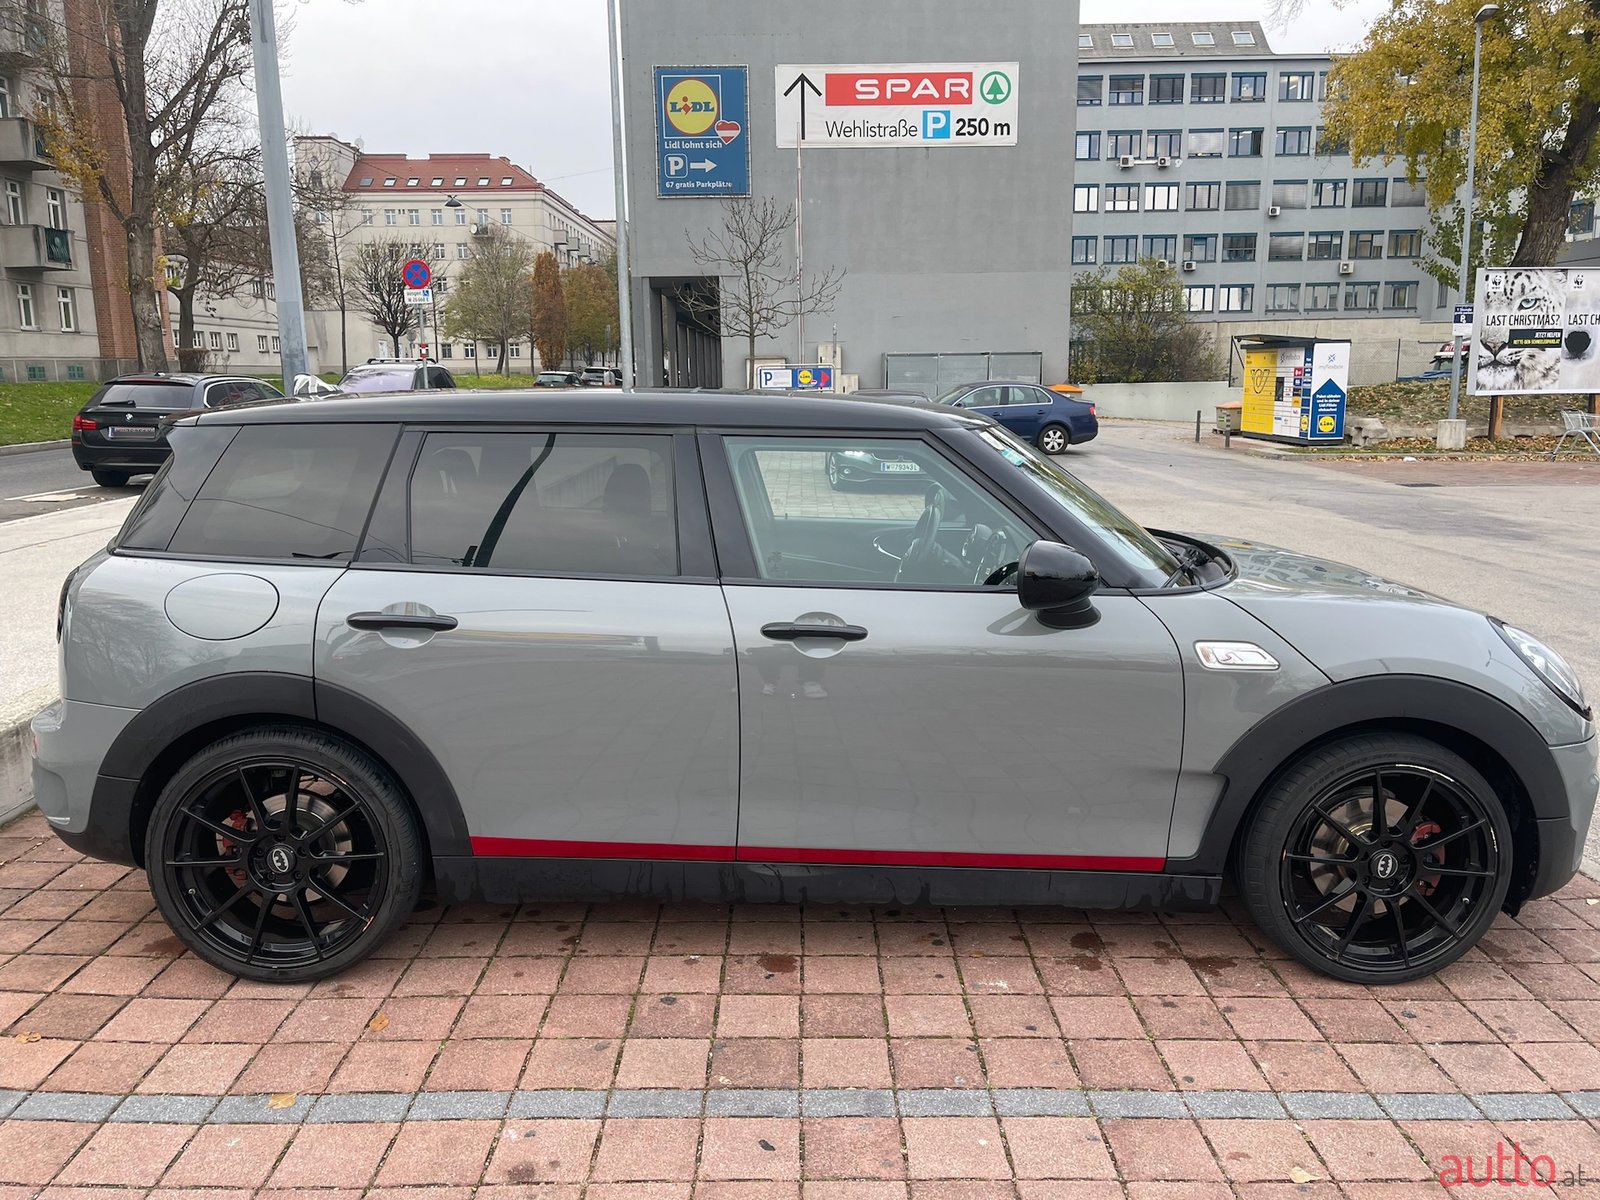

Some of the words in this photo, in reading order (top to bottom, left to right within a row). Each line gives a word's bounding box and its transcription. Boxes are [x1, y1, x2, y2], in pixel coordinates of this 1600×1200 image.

[855, 77, 970, 100] SPAR
[825, 118, 918, 138] Wehlistraße
[927, 112, 946, 137] P
[955, 117, 989, 136] 250
[993, 122, 1011, 136] m
[664, 141, 680, 149] Lidl
[682, 141, 704, 149] lohnt
[668, 156, 684, 176] P
[675, 181, 695, 189] gratis
[1486, 315, 1507, 326] LAST
[1508, 314, 1561, 326] CHRISTMAS?
[1568, 314, 1589, 326] LAST
[764, 372, 772, 386] P
